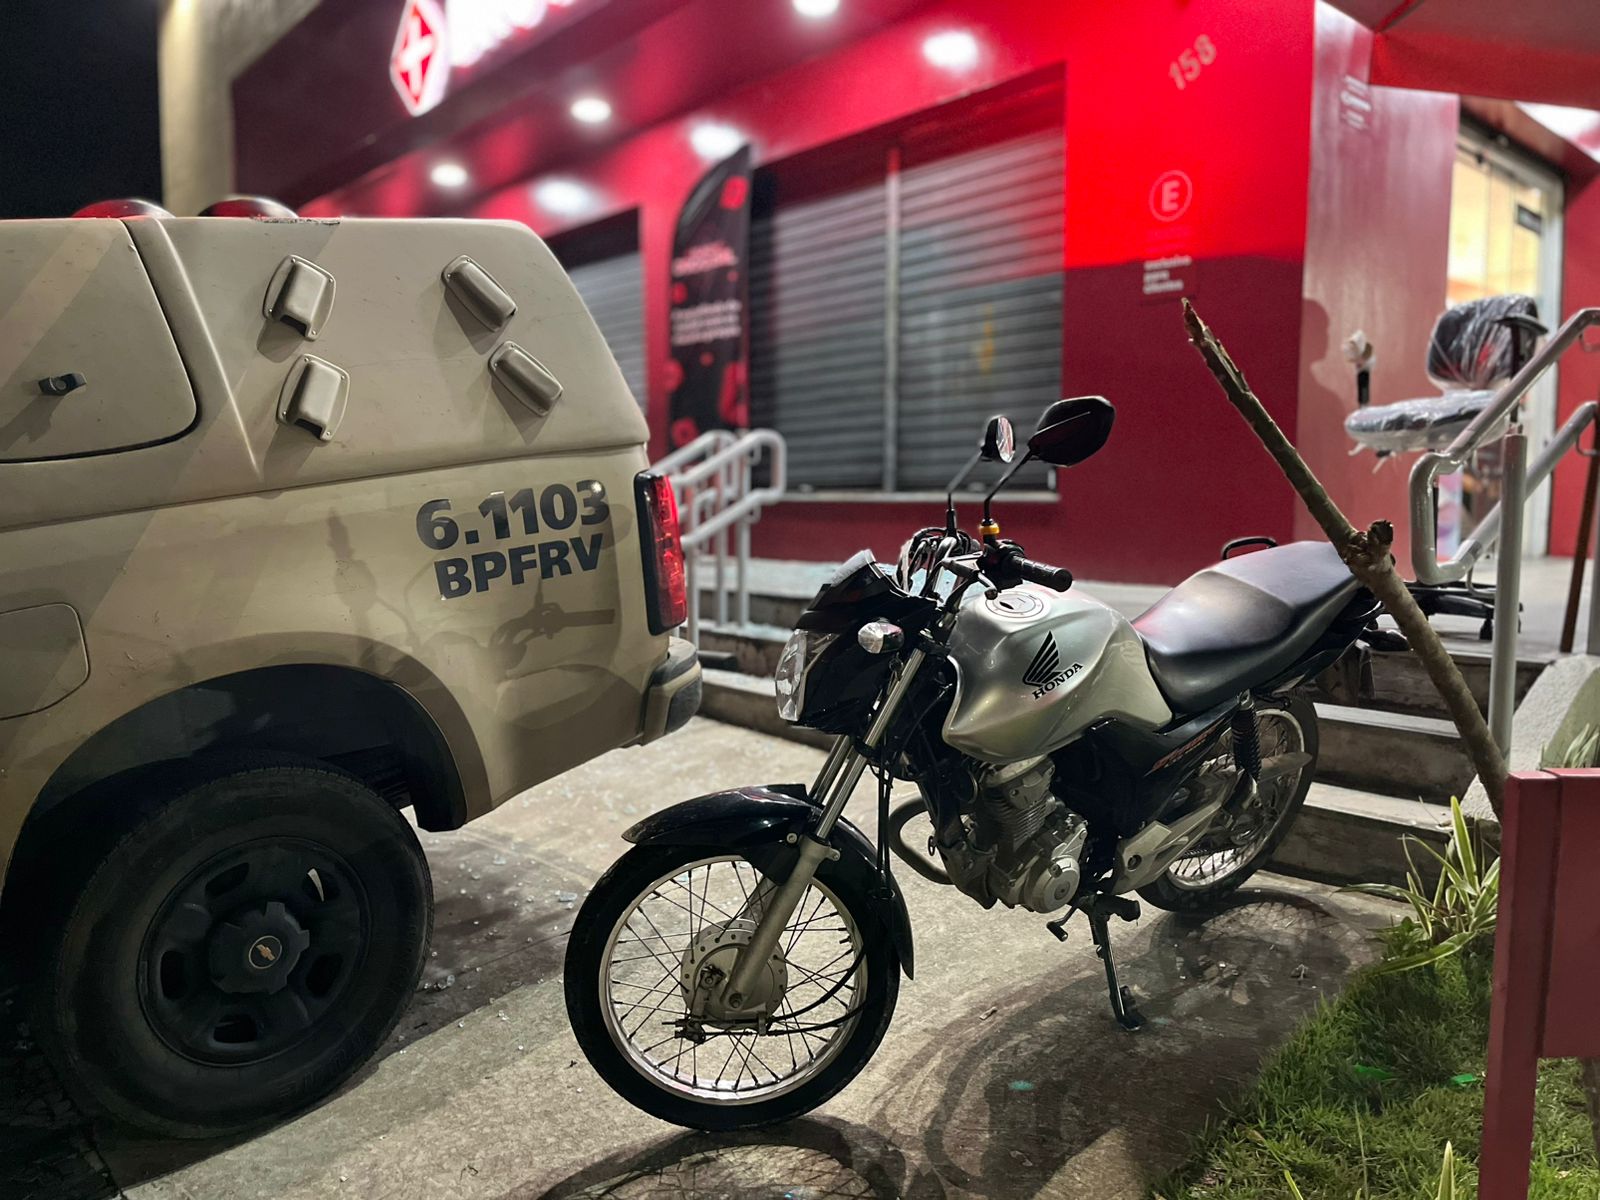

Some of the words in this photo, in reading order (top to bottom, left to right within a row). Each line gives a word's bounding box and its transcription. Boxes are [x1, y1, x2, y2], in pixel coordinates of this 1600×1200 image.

[1168, 34, 1217, 90] 158
[1161, 180, 1180, 211] E
[416, 479, 610, 550] 6.1103
[434, 533, 604, 600] BPFRV
[1031, 662, 1083, 700] HONDA
